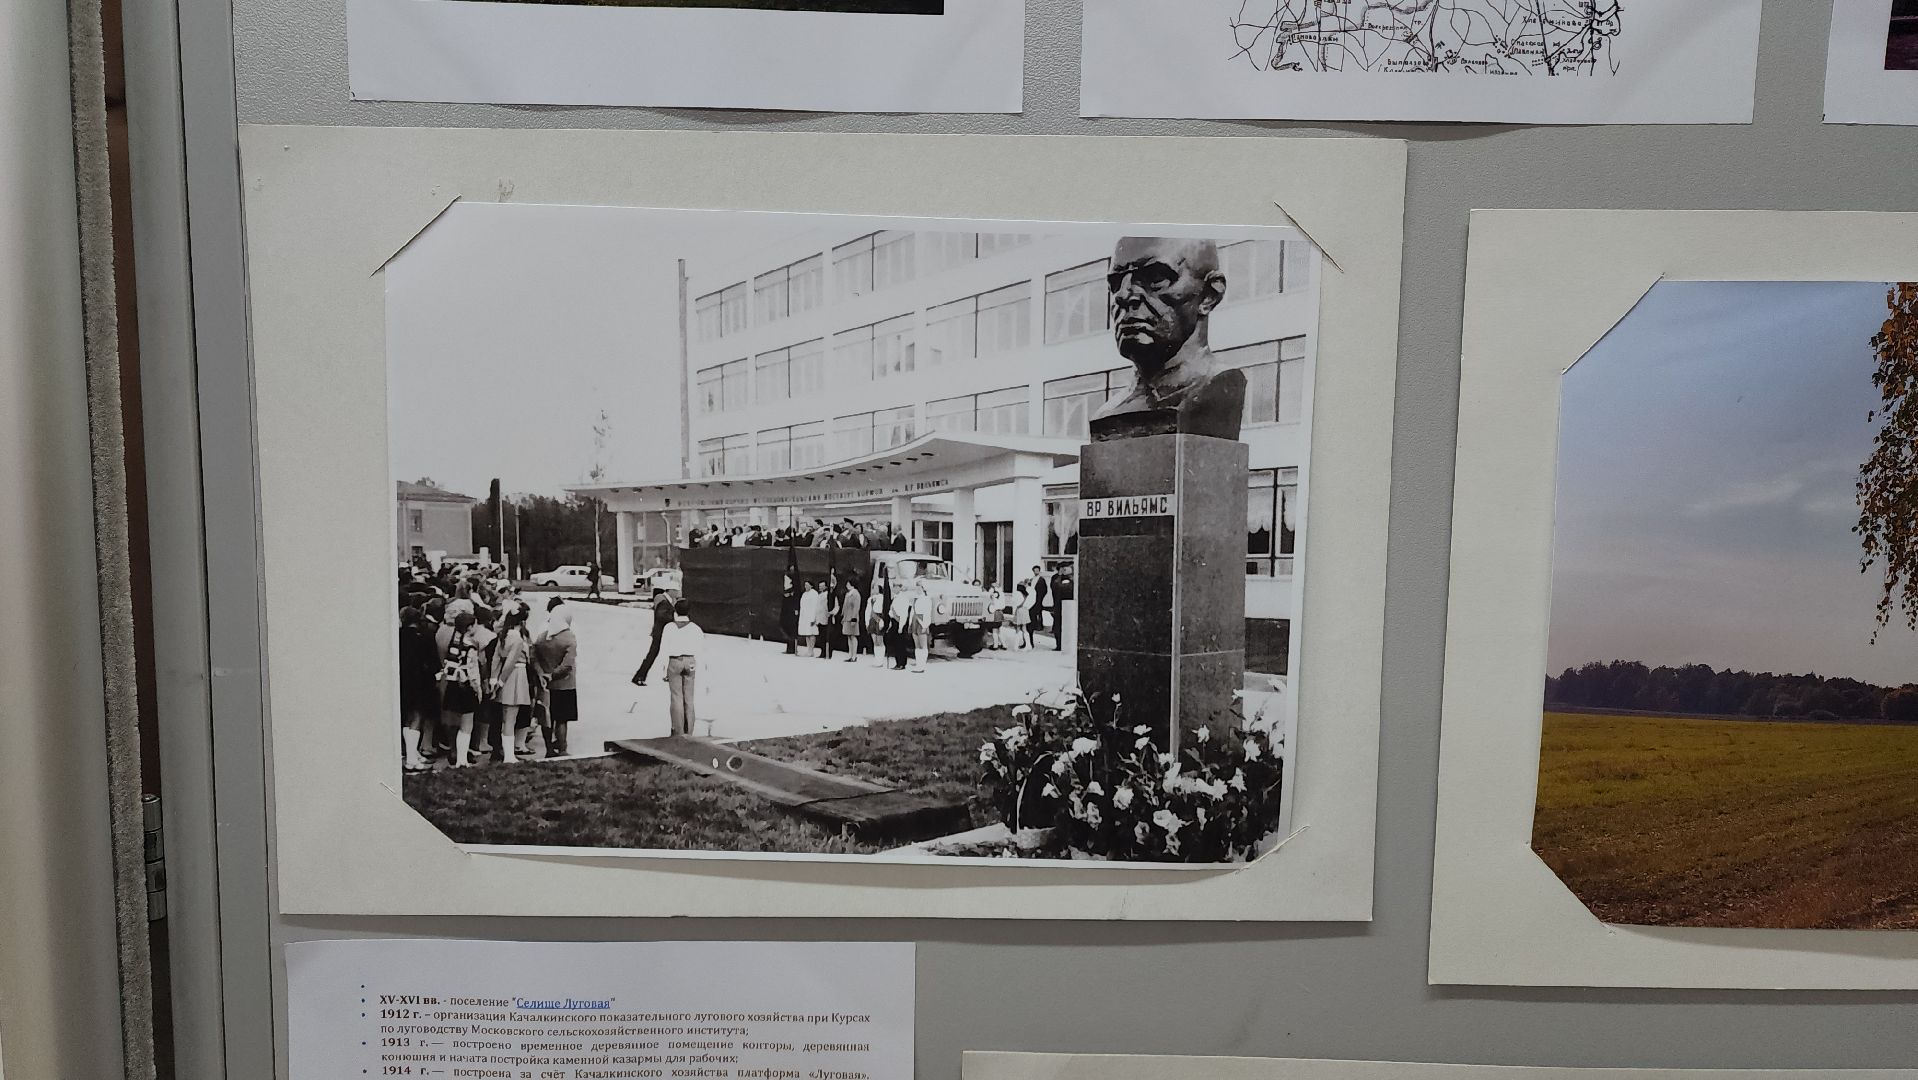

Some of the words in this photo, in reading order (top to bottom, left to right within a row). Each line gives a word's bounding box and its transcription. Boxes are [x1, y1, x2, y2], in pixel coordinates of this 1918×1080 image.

[1108, 497, 1167, 516] ВИЛЬЯМС
[423, 997, 440, 1006] вв.
[450, 997, 509, 1008] поселение
[380, 1008, 409, 1020] 1912
[413, 1011, 421, 1020] г.
[434, 1011, 505, 1023] организация
[510, 1011, 596, 1023] Качалкинского
[600, 1013, 691, 1022] показательного
[694, 1013, 745, 1024] лугового
[748, 1011, 804, 1023] хозяйства
[807, 1015, 828, 1026] при
[832, 1012, 870, 1026] Курсах
[381, 1025, 394, 1034] по
[397, 1025, 468, 1037] луговодству
[472, 1024, 544, 1037] Московского
[547, 1025, 683, 1038] сельскохозяйственного
[687, 1027, 748, 1038] института;
[381, 1037, 410, 1048] 1913
[453, 1040, 511, 1052] построено
[521, 1043, 582, 1054] временное
[591, 1041, 659, 1053] деревянное
[668, 1041, 733, 1051] помещение
[743, 1041, 794, 1053] конторы,
[803, 1042, 869, 1054] деревянная
[382, 1053, 435, 1062] конюшня
[439, 1054, 446, 1062] и
[450, 1054, 487, 1064] начата
[491, 1054, 549, 1067] постройка
[553, 1054, 609, 1065] каменной
[613, 1055, 661, 1067] казармы
[665, 1055, 685, 1065] для
[689, 1052, 738, 1066] рабочих;
[383, 1065, 411, 1076] 1914
[454, 1068, 511, 1080] построена
[520, 1071, 531, 1079] за
[541, 1069, 565, 1080] счёт
[575, 1068, 662, 1079] Качалкинского
[672, 1066, 728, 1079] хозяйства
[738, 1067, 799, 1080] платформа
[809, 1068, 869, 1080] «Луговая».
